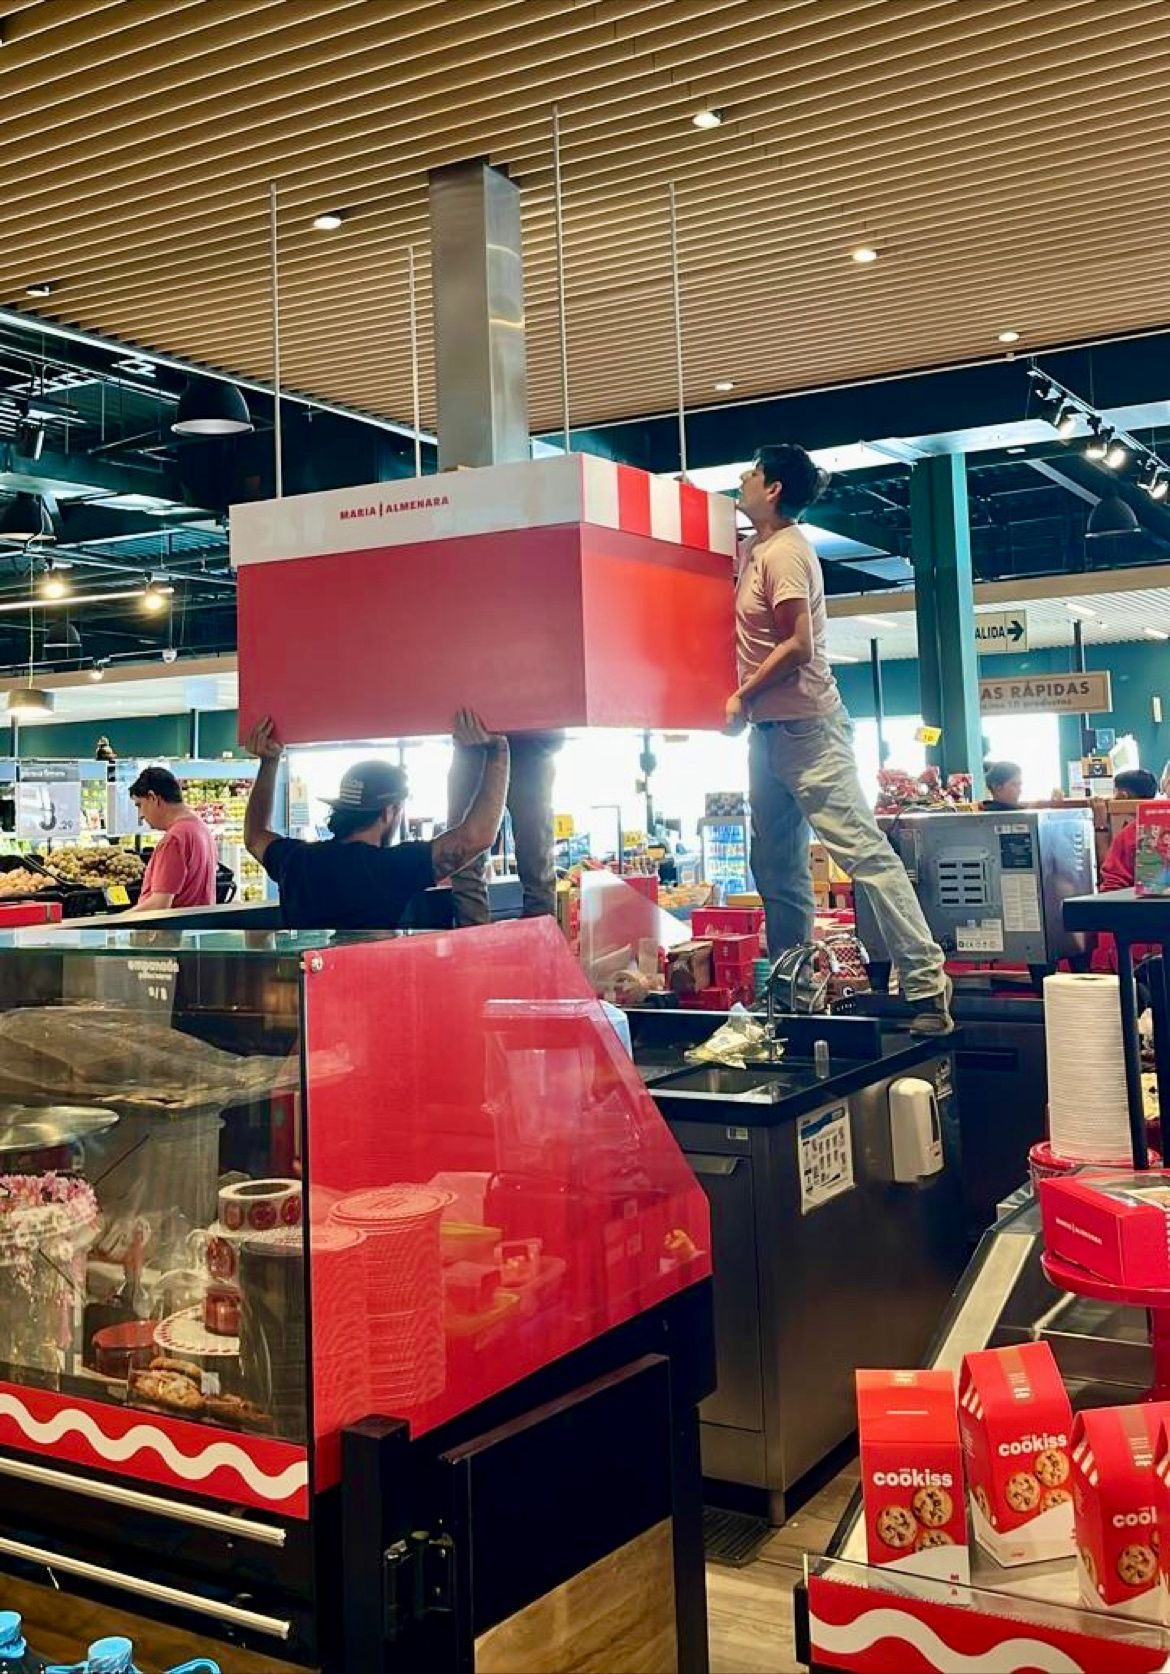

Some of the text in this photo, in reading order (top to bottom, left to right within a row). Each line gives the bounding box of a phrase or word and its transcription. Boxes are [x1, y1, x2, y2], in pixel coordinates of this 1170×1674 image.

[340, 496, 449, 519] MARIA ALMENARA
[1011, 681, 1090, 698] RÁPIDAS
